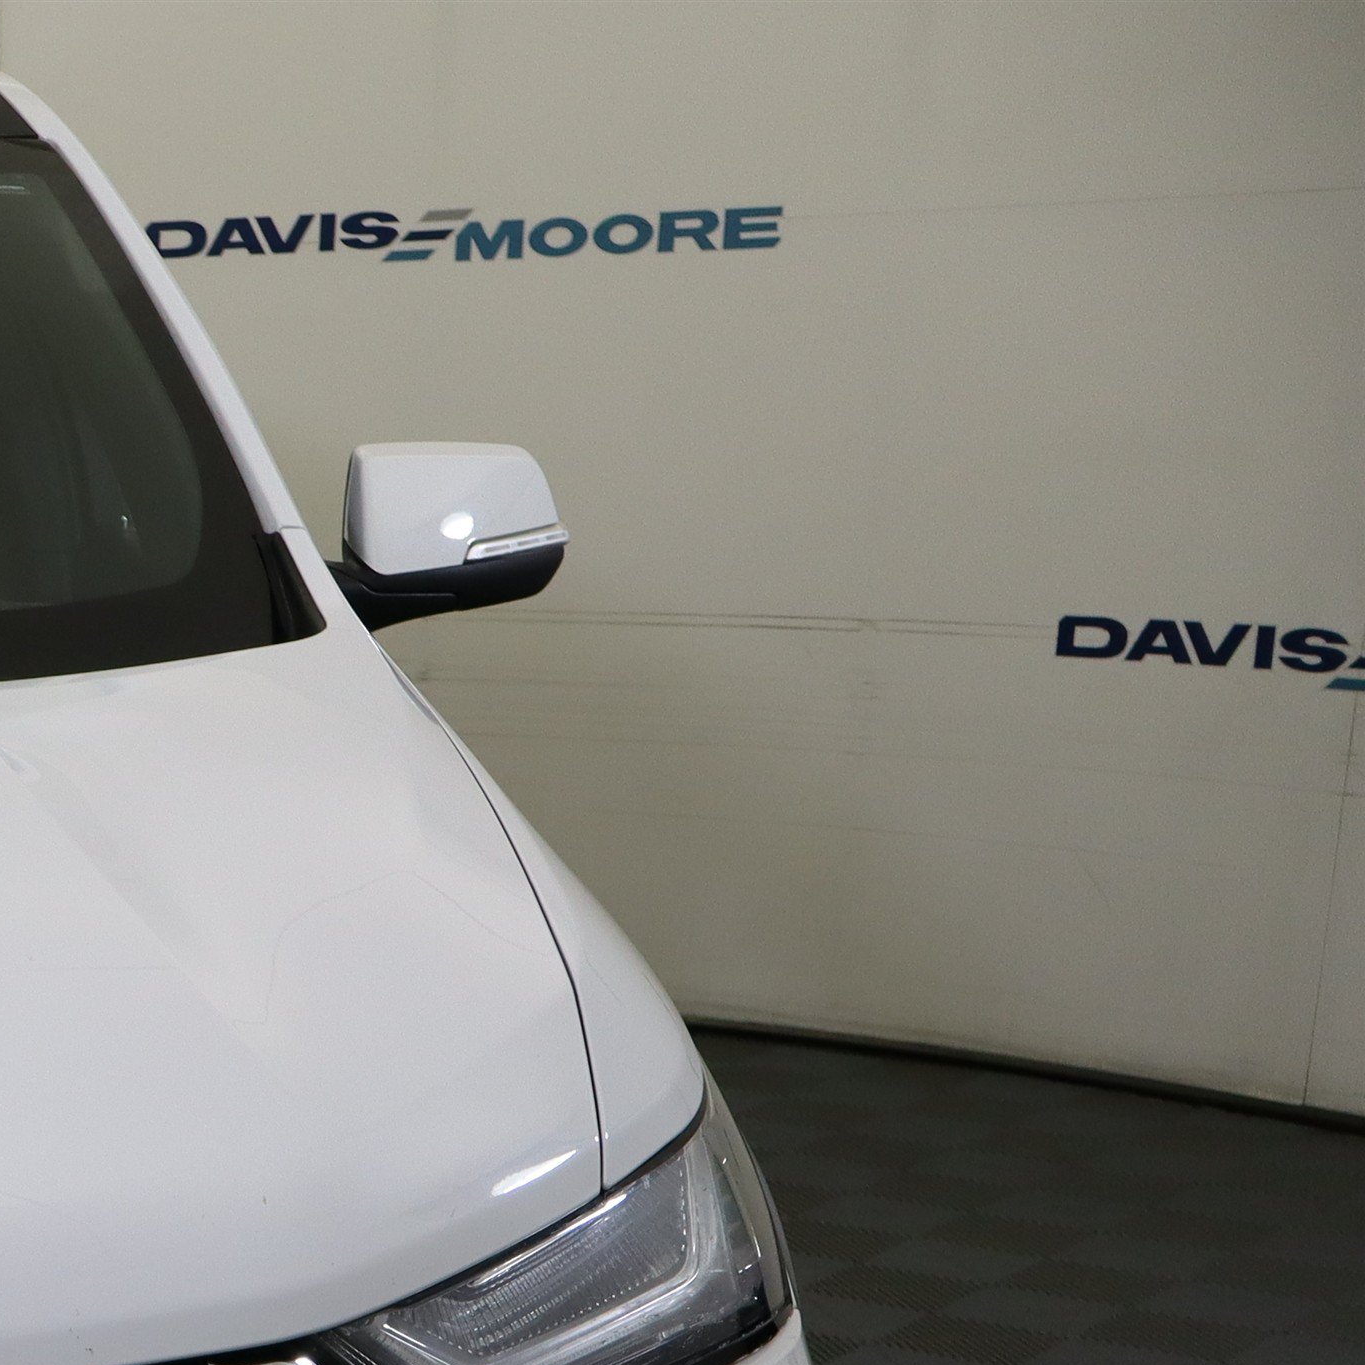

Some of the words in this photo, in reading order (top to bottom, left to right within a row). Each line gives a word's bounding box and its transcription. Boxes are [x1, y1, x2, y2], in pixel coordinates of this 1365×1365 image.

[144, 210, 401, 259] DAVIS
[455, 205, 784, 262] MOORE
[1055, 614, 1349, 674] DAVIS
